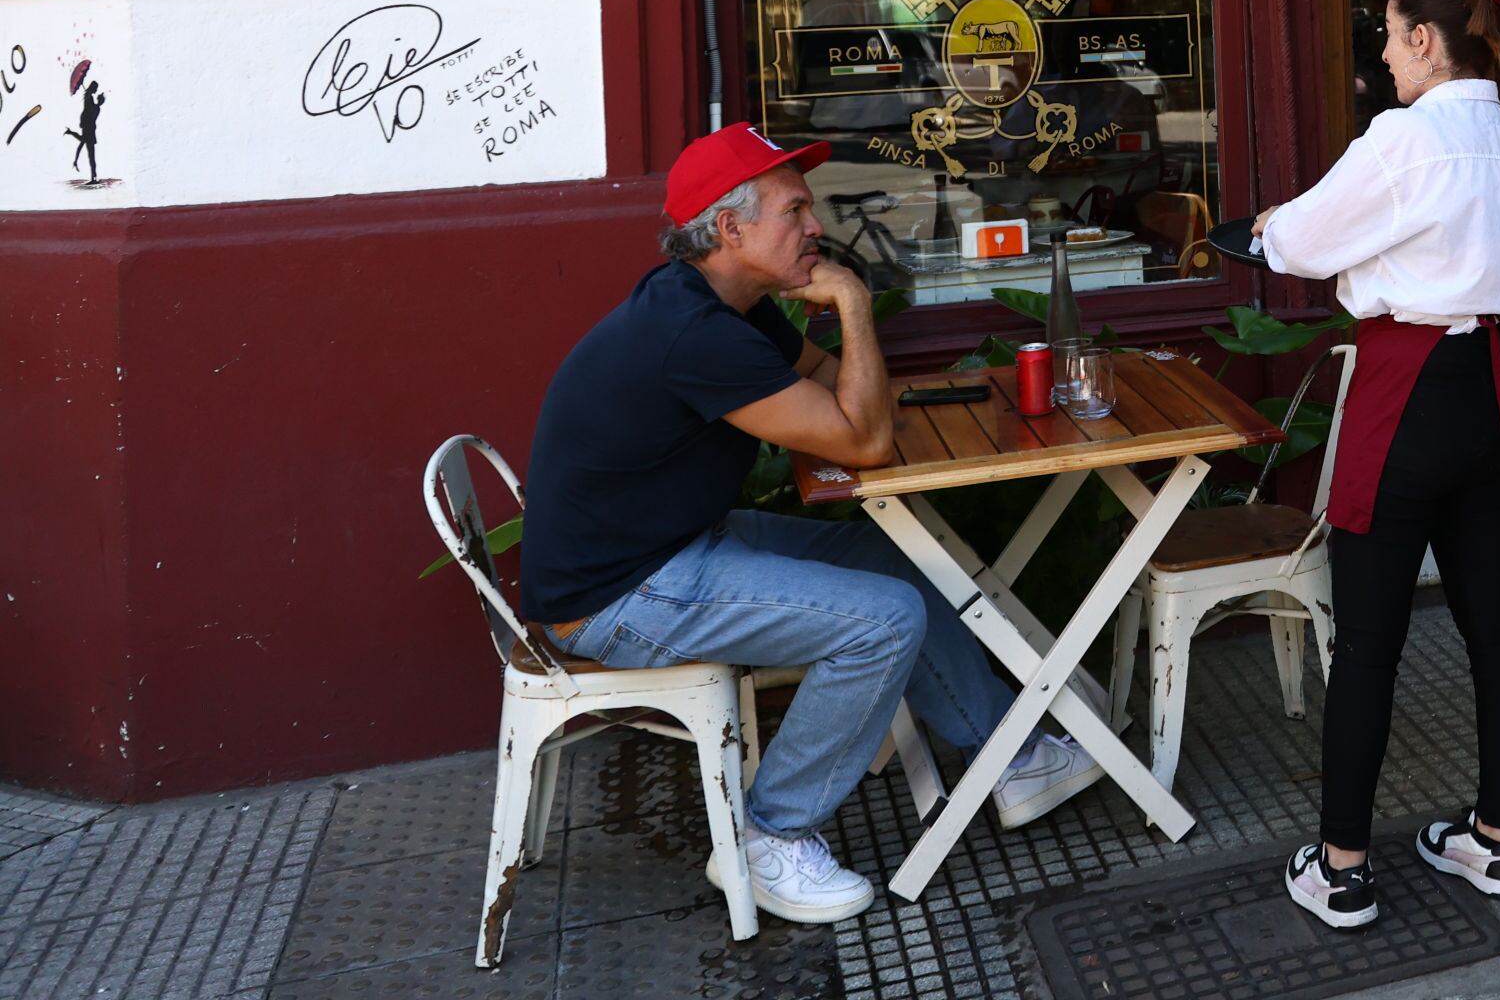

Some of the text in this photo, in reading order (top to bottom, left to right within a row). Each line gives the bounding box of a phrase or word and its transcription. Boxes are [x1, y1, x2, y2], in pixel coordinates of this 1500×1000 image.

[829, 46, 902, 62] ROMA
[1079, 33, 1145, 50] BS. AS.
[446, 49, 523, 105] SE ESCRIBE
[473, 61, 538, 107] TOTTI
[474, 84, 535, 134] SE LEE
[482, 100, 556, 161] ROMA
[868, 122, 1123, 176] PINSA DI ROMA
